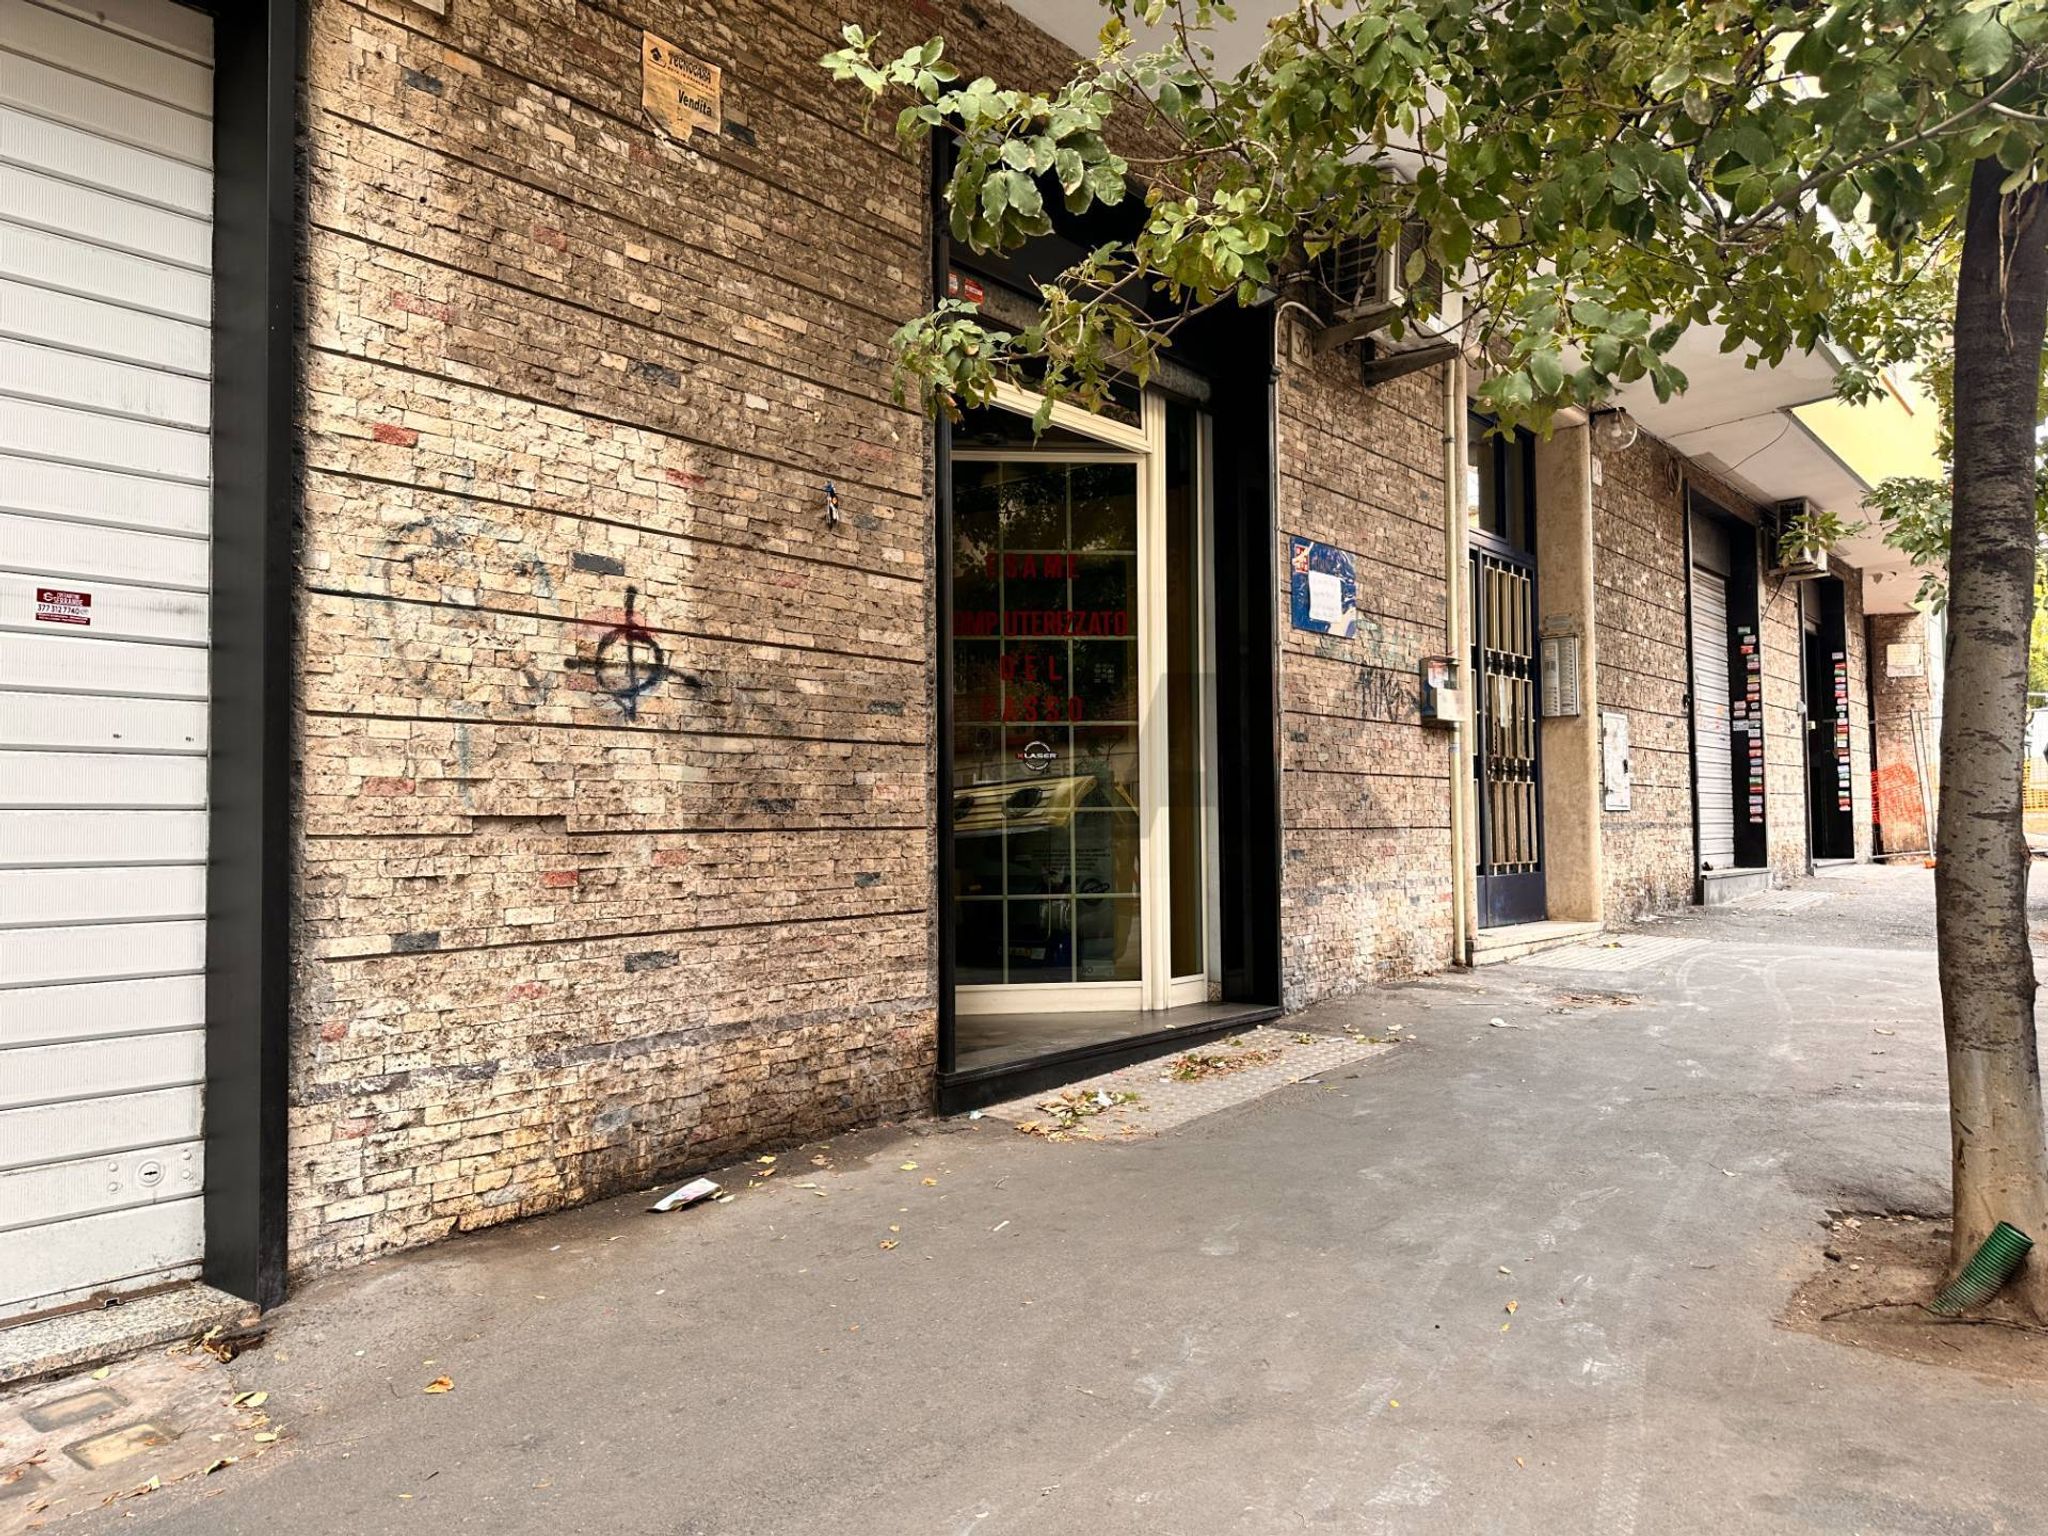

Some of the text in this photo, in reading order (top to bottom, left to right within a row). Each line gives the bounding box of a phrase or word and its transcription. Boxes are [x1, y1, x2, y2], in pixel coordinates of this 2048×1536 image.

[678, 89, 712, 116] Vendita
[985, 553, 1079, 579] ESAME
[1001, 655, 1062, 682] DEL
